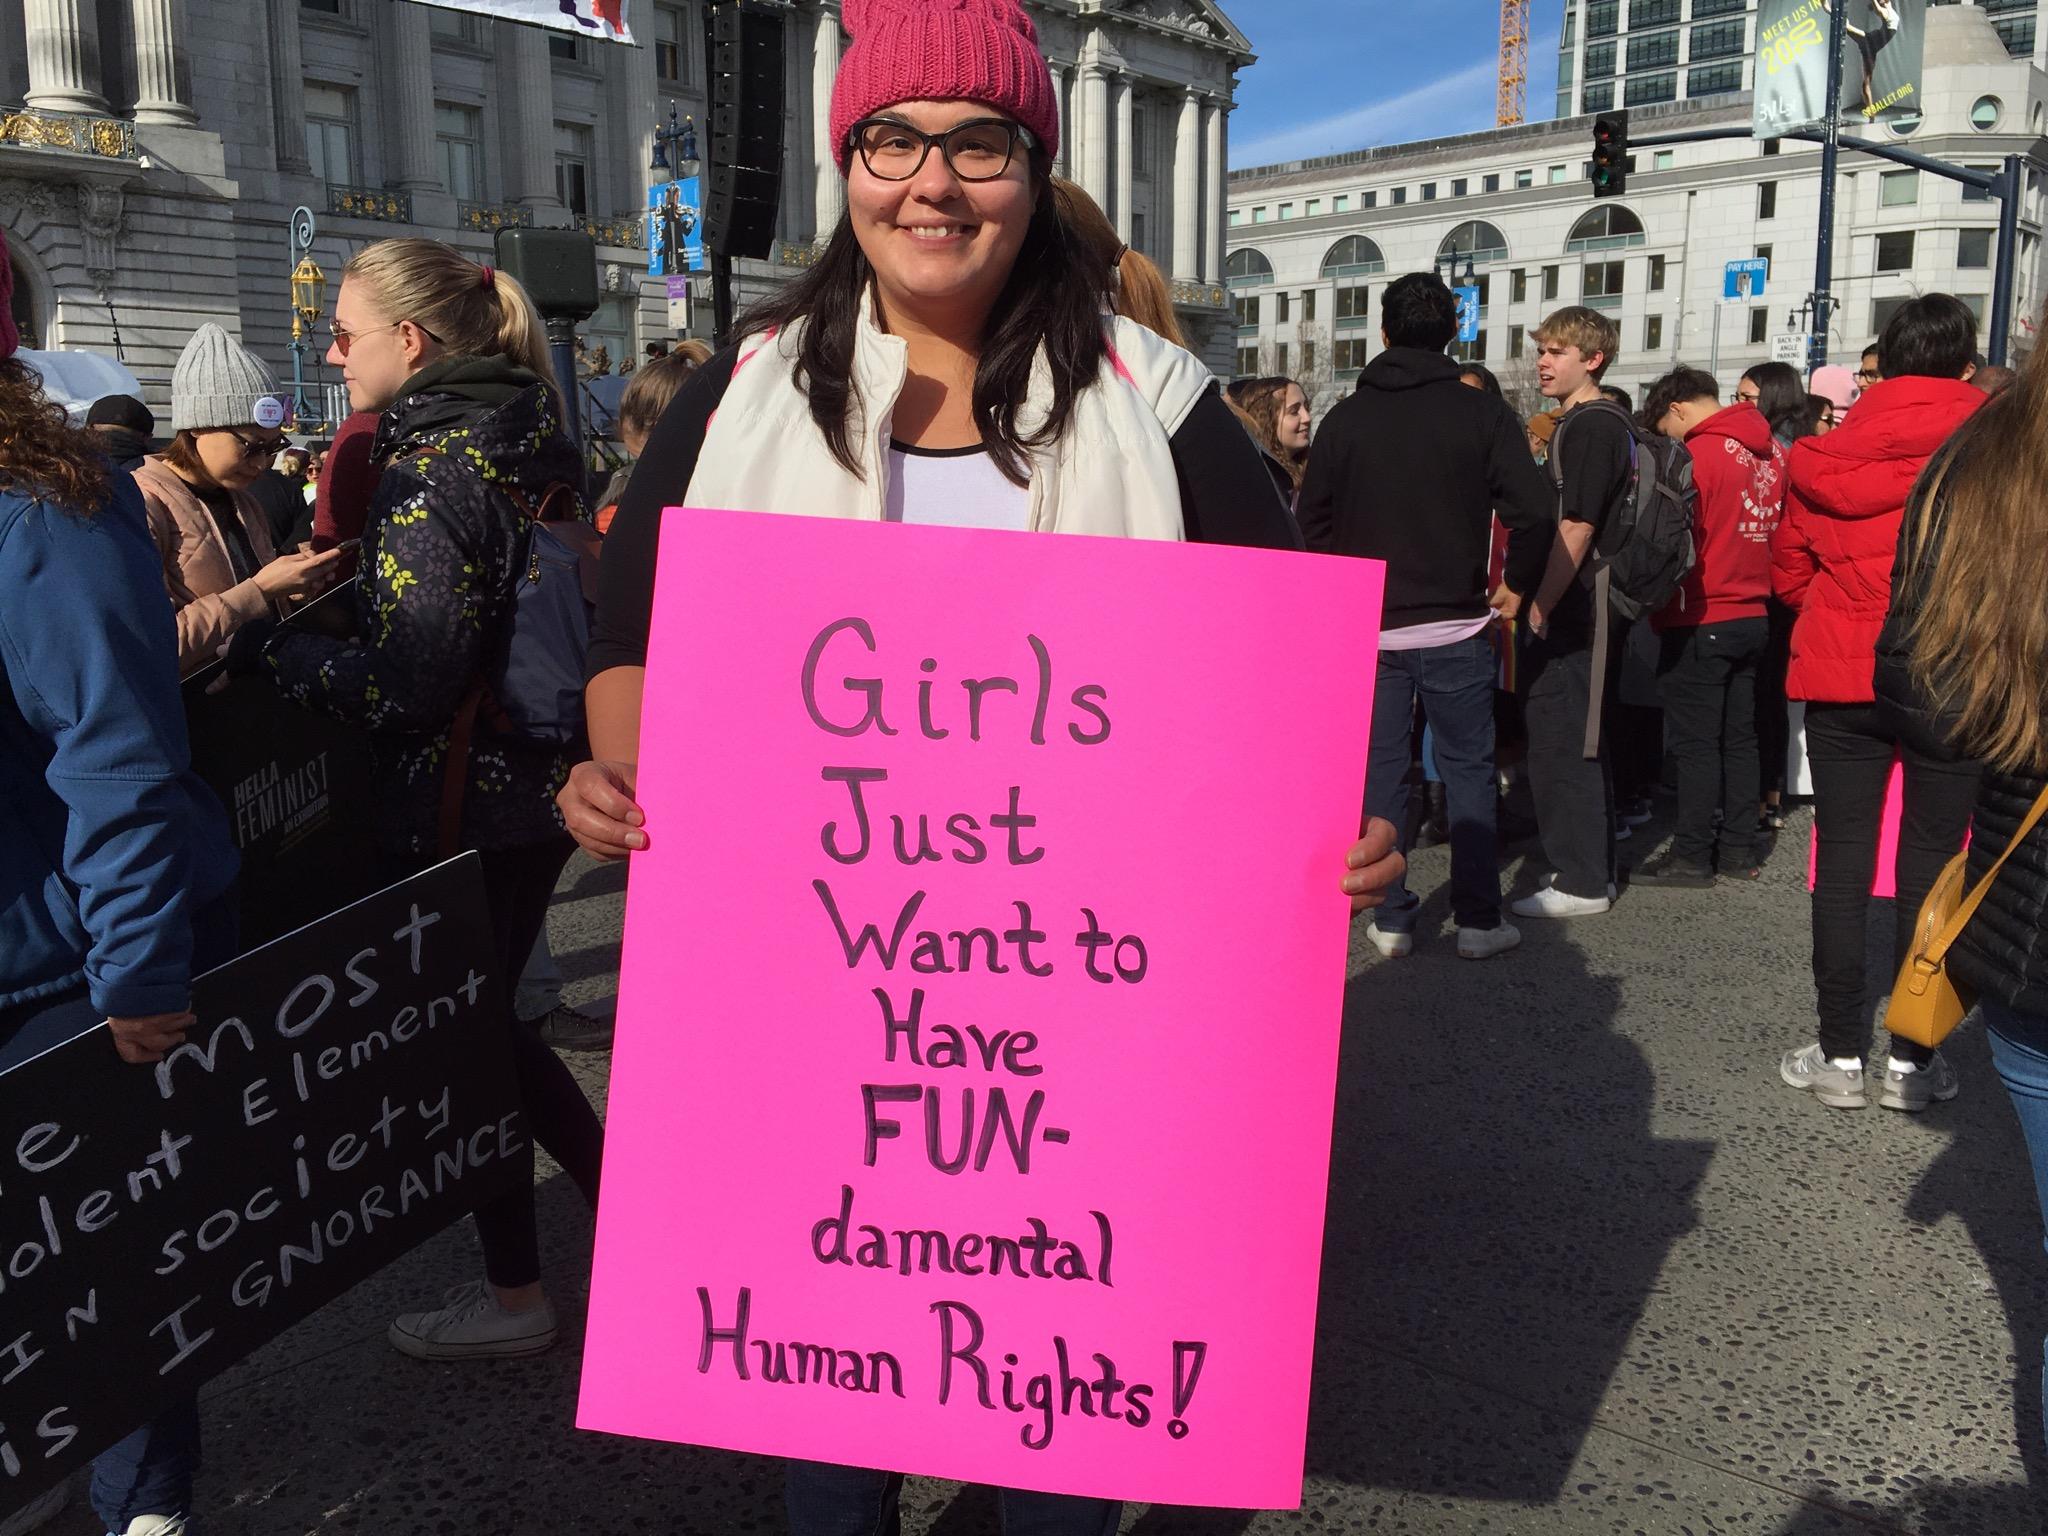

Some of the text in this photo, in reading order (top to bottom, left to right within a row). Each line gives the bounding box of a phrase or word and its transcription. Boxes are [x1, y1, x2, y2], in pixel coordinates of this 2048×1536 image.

[1762, 0, 1822, 42] MEET US IN
[1727, 260, 1765, 273] PAY HERE
[1777, 352, 1801, 360] PARKING
[800, 616, 1112, 746] Girls
[234, 760, 280, 809] HELLA
[236, 751, 328, 849] FEMINIST
[820, 765, 1045, 865] Just
[812, 878, 1148, 984] Want to
[871, 987, 1044, 1077] Have
[0, 968, 487, 1285] olent Element
[861, 1083, 1071, 1176] FUN-
[154, 1086, 450, 1275] society
[149, 1110, 525, 1376] IGNORANCE
[811, 1184, 1115, 1288] damental
[696, 1286, 1208, 1451] Human Rights!
